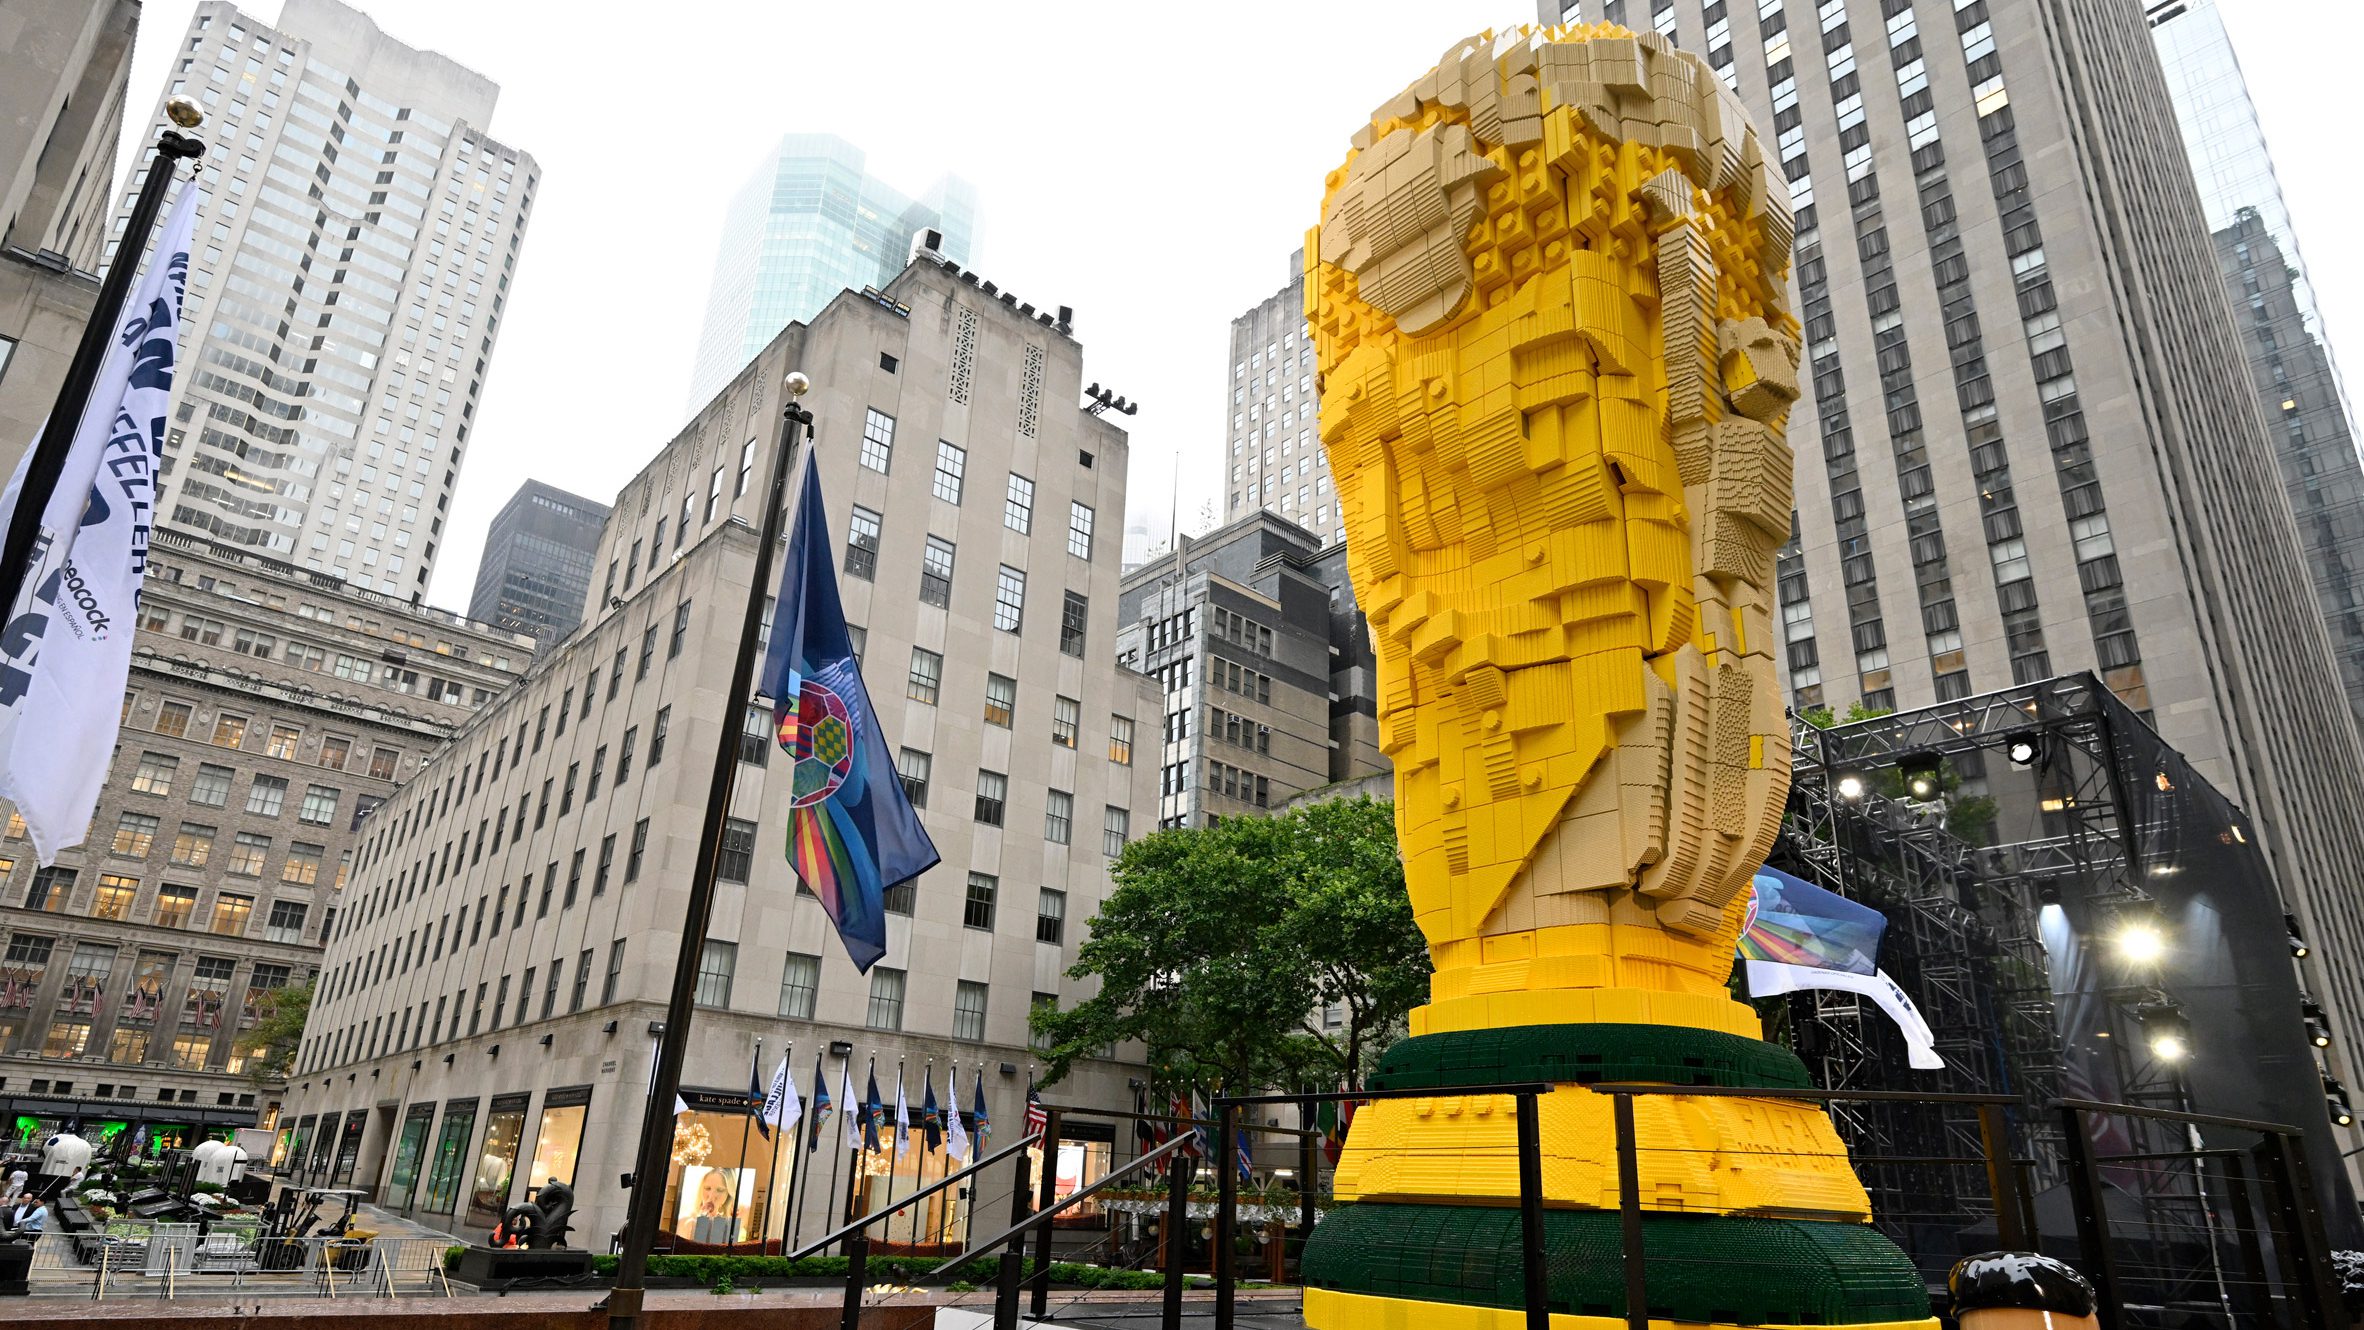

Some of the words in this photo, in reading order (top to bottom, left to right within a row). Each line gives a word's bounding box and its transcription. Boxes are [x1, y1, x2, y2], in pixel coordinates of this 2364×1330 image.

[699, 1094, 716, 1103] kate
[718, 1097, 741, 1106] spade
[1733, 1102, 1823, 1150] FIFA
[1737, 1142, 1799, 1169] WORLD
